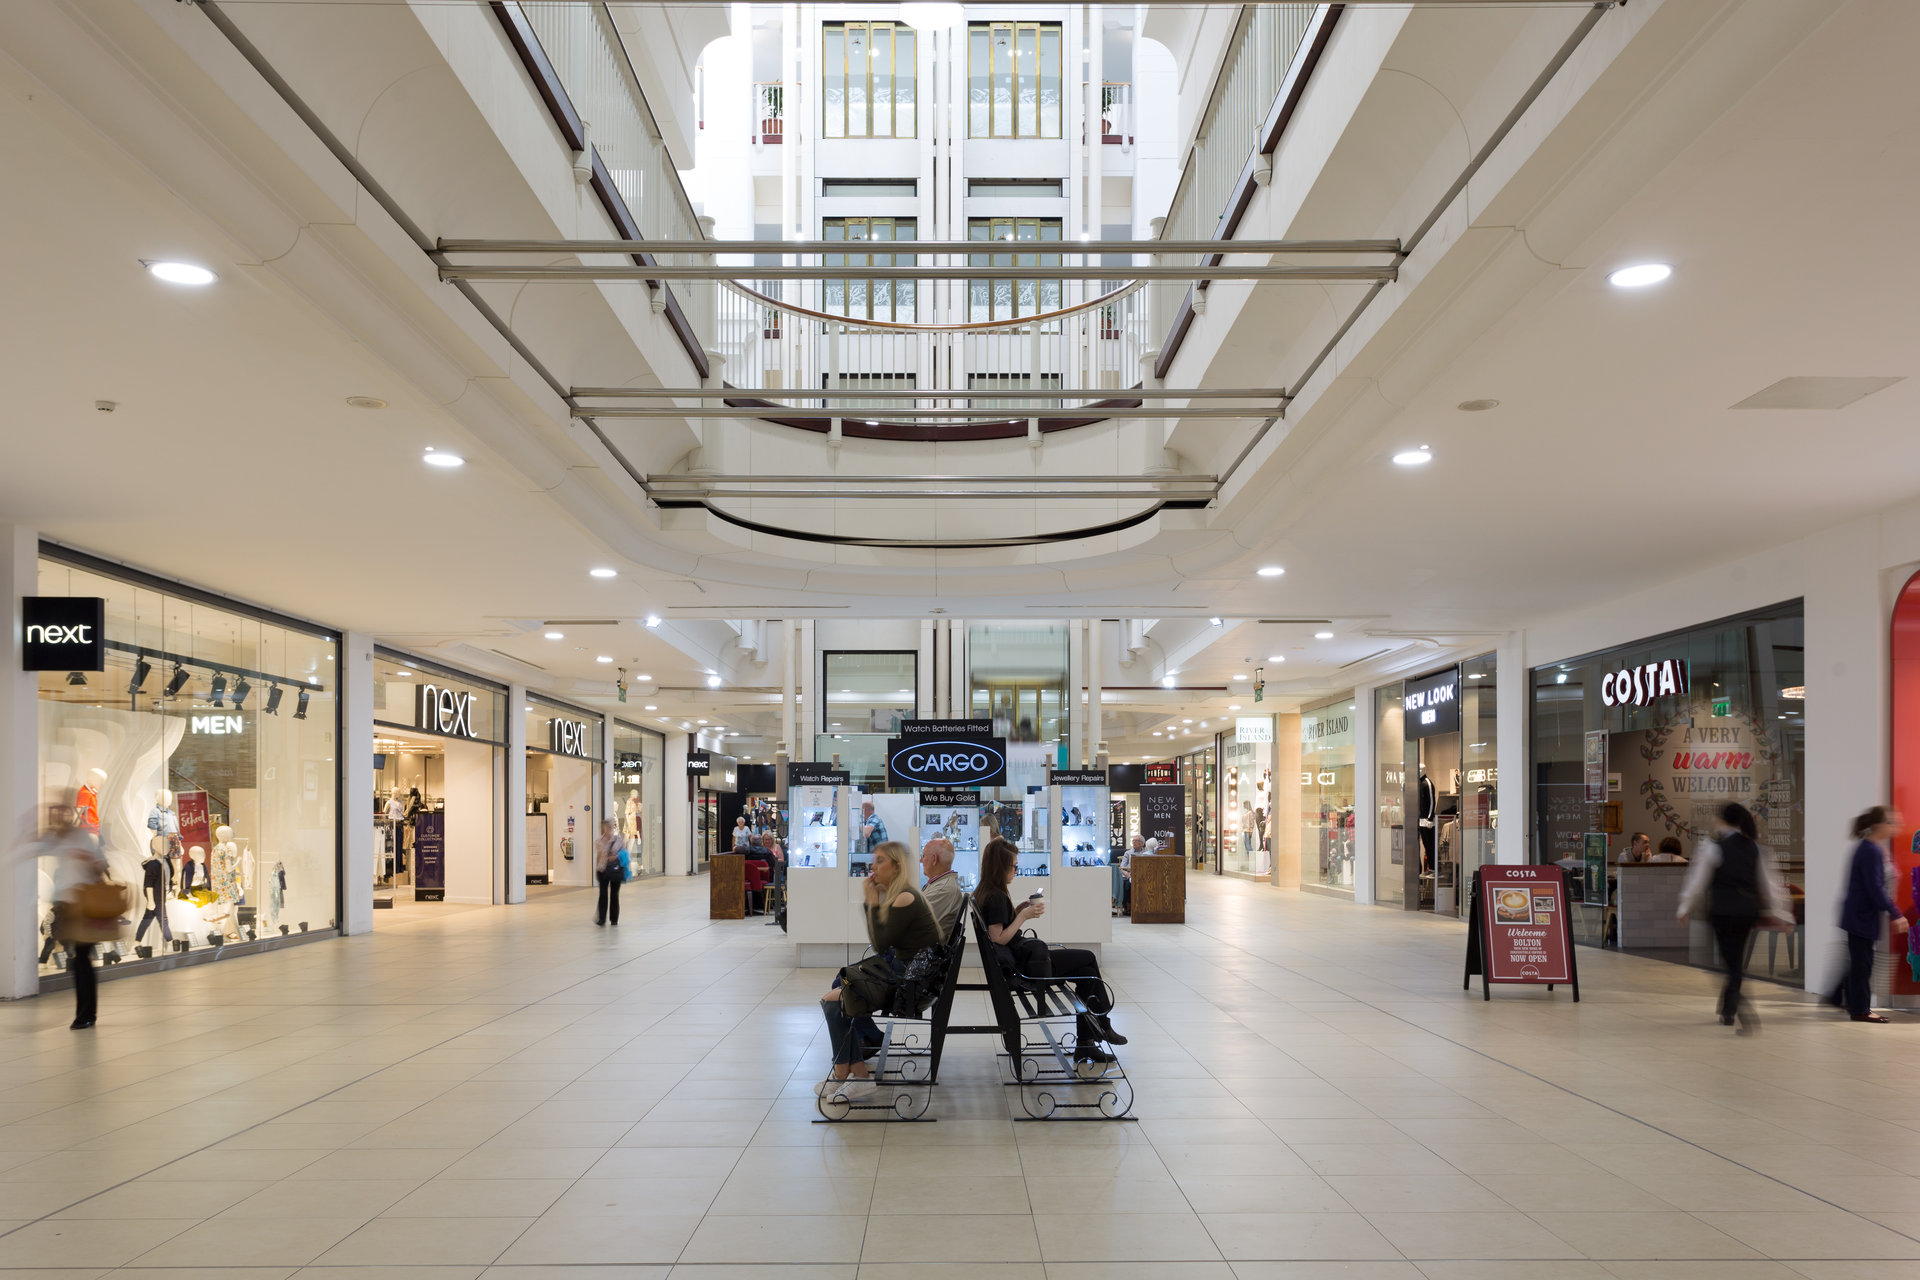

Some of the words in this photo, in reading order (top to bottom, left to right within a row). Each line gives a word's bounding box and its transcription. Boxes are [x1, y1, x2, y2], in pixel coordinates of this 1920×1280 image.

[27, 624, 93, 644] next
[1601, 659, 1676, 707] COSTA
[1405, 691, 1425, 711] NEW
[1427, 684, 1454, 706] LOOK
[422, 684, 478, 738] next
[191, 715, 243, 735] MEN
[904, 725, 930, 733] Watch
[932, 725, 966, 733] Batteries
[967, 724, 989, 732] Fitted
[1308, 722, 1324, 740] RIVER
[1326, 716, 1349, 736] ISLAND
[555, 718, 588, 757] next
[1682, 727, 1692, 743] A
[1698, 727, 1741, 744] VERY
[687, 760, 709, 769] next
[907, 753, 988, 772] CARGO
[1672, 751, 1755, 770] warm
[820, 775, 844, 783] Repairs
[1051, 774, 1080, 783] Jewellery
[1081, 774, 1105, 783] Repairs
[1672, 776, 1751, 793] WELCOME
[924, 794, 938, 802] We
[940, 794, 954, 803] Buy
[956, 793, 976, 802] Gold
[1148, 796, 1176, 804] NEW
[1130, 806, 1140, 847] INIQUE
[1506, 870, 1537, 878] COSTA
[1507, 928, 1547, 937] Welcome
[1513, 938, 1541, 946] BOLTON
[1510, 954, 1527, 962] NOW
[1528, 954, 1547, 963] OPEN
